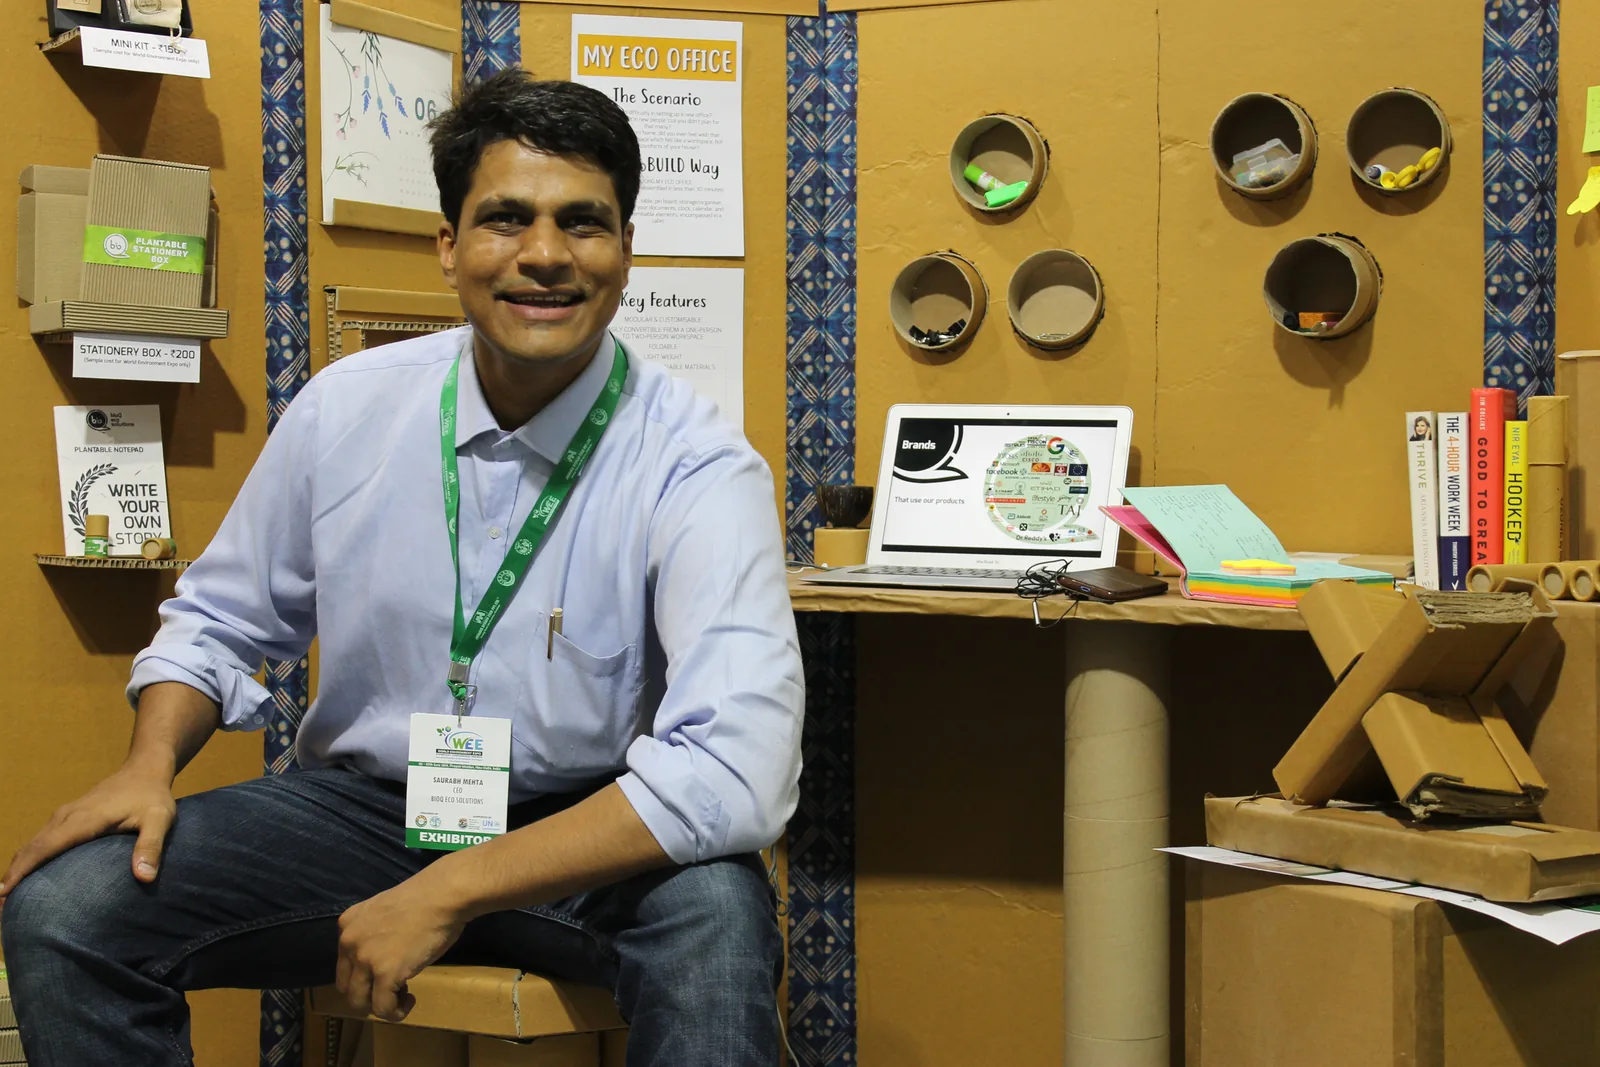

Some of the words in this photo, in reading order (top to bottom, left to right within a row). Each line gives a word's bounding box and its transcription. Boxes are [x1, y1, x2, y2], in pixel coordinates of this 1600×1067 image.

[111, 38, 132, 49] MINI
[134, 42, 149, 51] KIT
[583, 45, 614, 68] MY
[620, 46, 659, 71] ECO
[667, 47, 733, 74] OFFICE
[613, 87, 636, 104] The
[641, 88, 702, 106] Scenario
[640, 156, 685, 173] oBUILD
[690, 158, 719, 180] Way
[133, 245, 189, 258] STATIONERY
[136, 237, 188, 250] PLANTABLE
[151, 255, 169, 264] BOX
[620, 292, 645, 313] Key
[650, 292, 707, 308] Features
[80, 344, 140, 357] STATIONERY
[142, 348, 162, 358] BOX
[170, 349, 196, 360] ₹200
[1446, 416, 1460, 434] THE
[1512, 427, 1520, 442] NIR
[902, 440, 936, 451] Brands
[1447, 436, 1460, 473] 4-HOUR
[1477, 437, 1488, 481] GOOD
[1512, 444, 1520, 466] EYAL
[1416, 443, 1427, 489] THRIVE
[108, 484, 158, 497] WRITE
[1447, 475, 1460, 502] WORK
[118, 500, 160, 513] YOUR
[894, 496, 913, 504] That
[935, 496, 965, 506] products
[1477, 490, 1488, 509] TO
[1507, 473, 1523, 541] HOOKED
[1058, 504, 1082, 518] TAJ
[1448, 503, 1461, 532] WEEK
[124, 516, 162, 529] OWN
[1477, 518, 1488, 564] GREA
[452, 738, 484, 750] WEE
[433, 777, 462, 785] SAURABH
